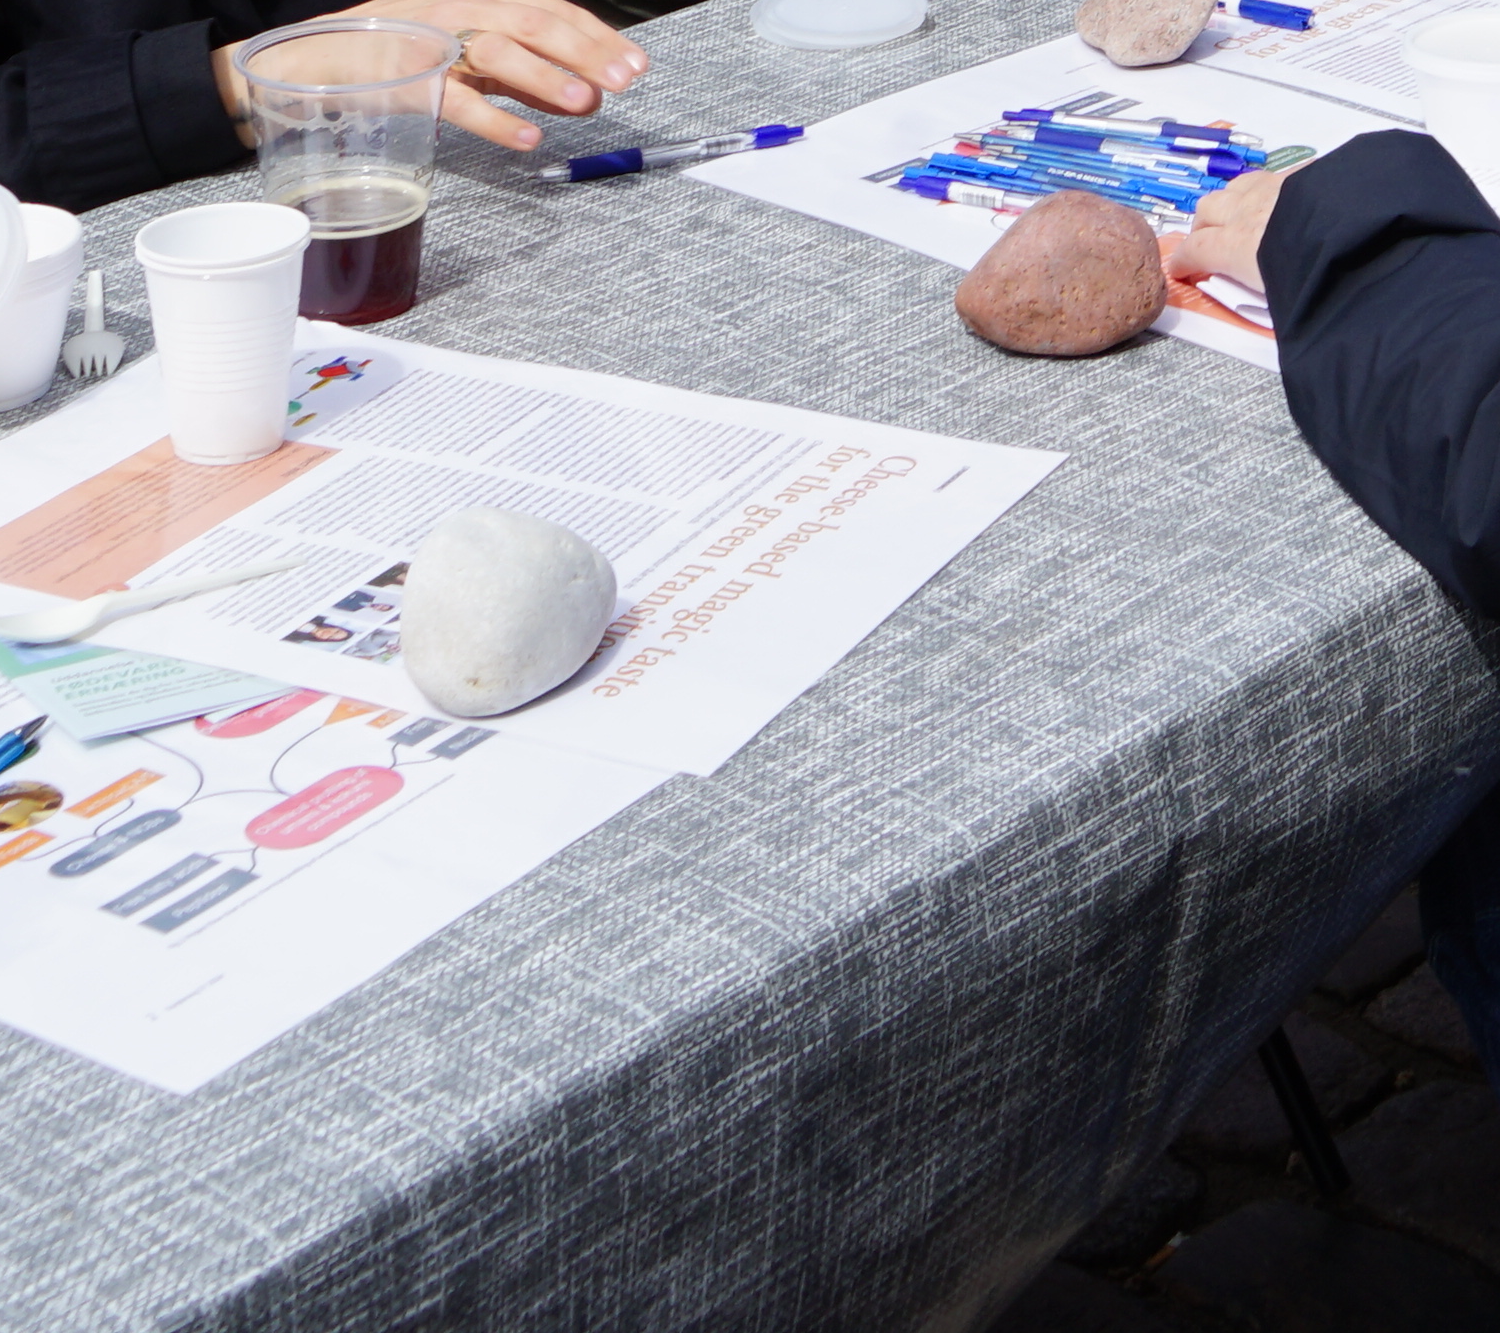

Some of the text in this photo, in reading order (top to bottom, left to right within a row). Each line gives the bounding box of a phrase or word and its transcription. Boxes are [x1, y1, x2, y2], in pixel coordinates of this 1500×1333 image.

[1244, 41, 1287, 60] for
[1324, 2, 1386, 30] green
[816, 444, 872, 473] for
[774, 473, 830, 505] the
[700, 504, 782, 559] green
[592, 454, 918, 698] Cheese-based magic taste
